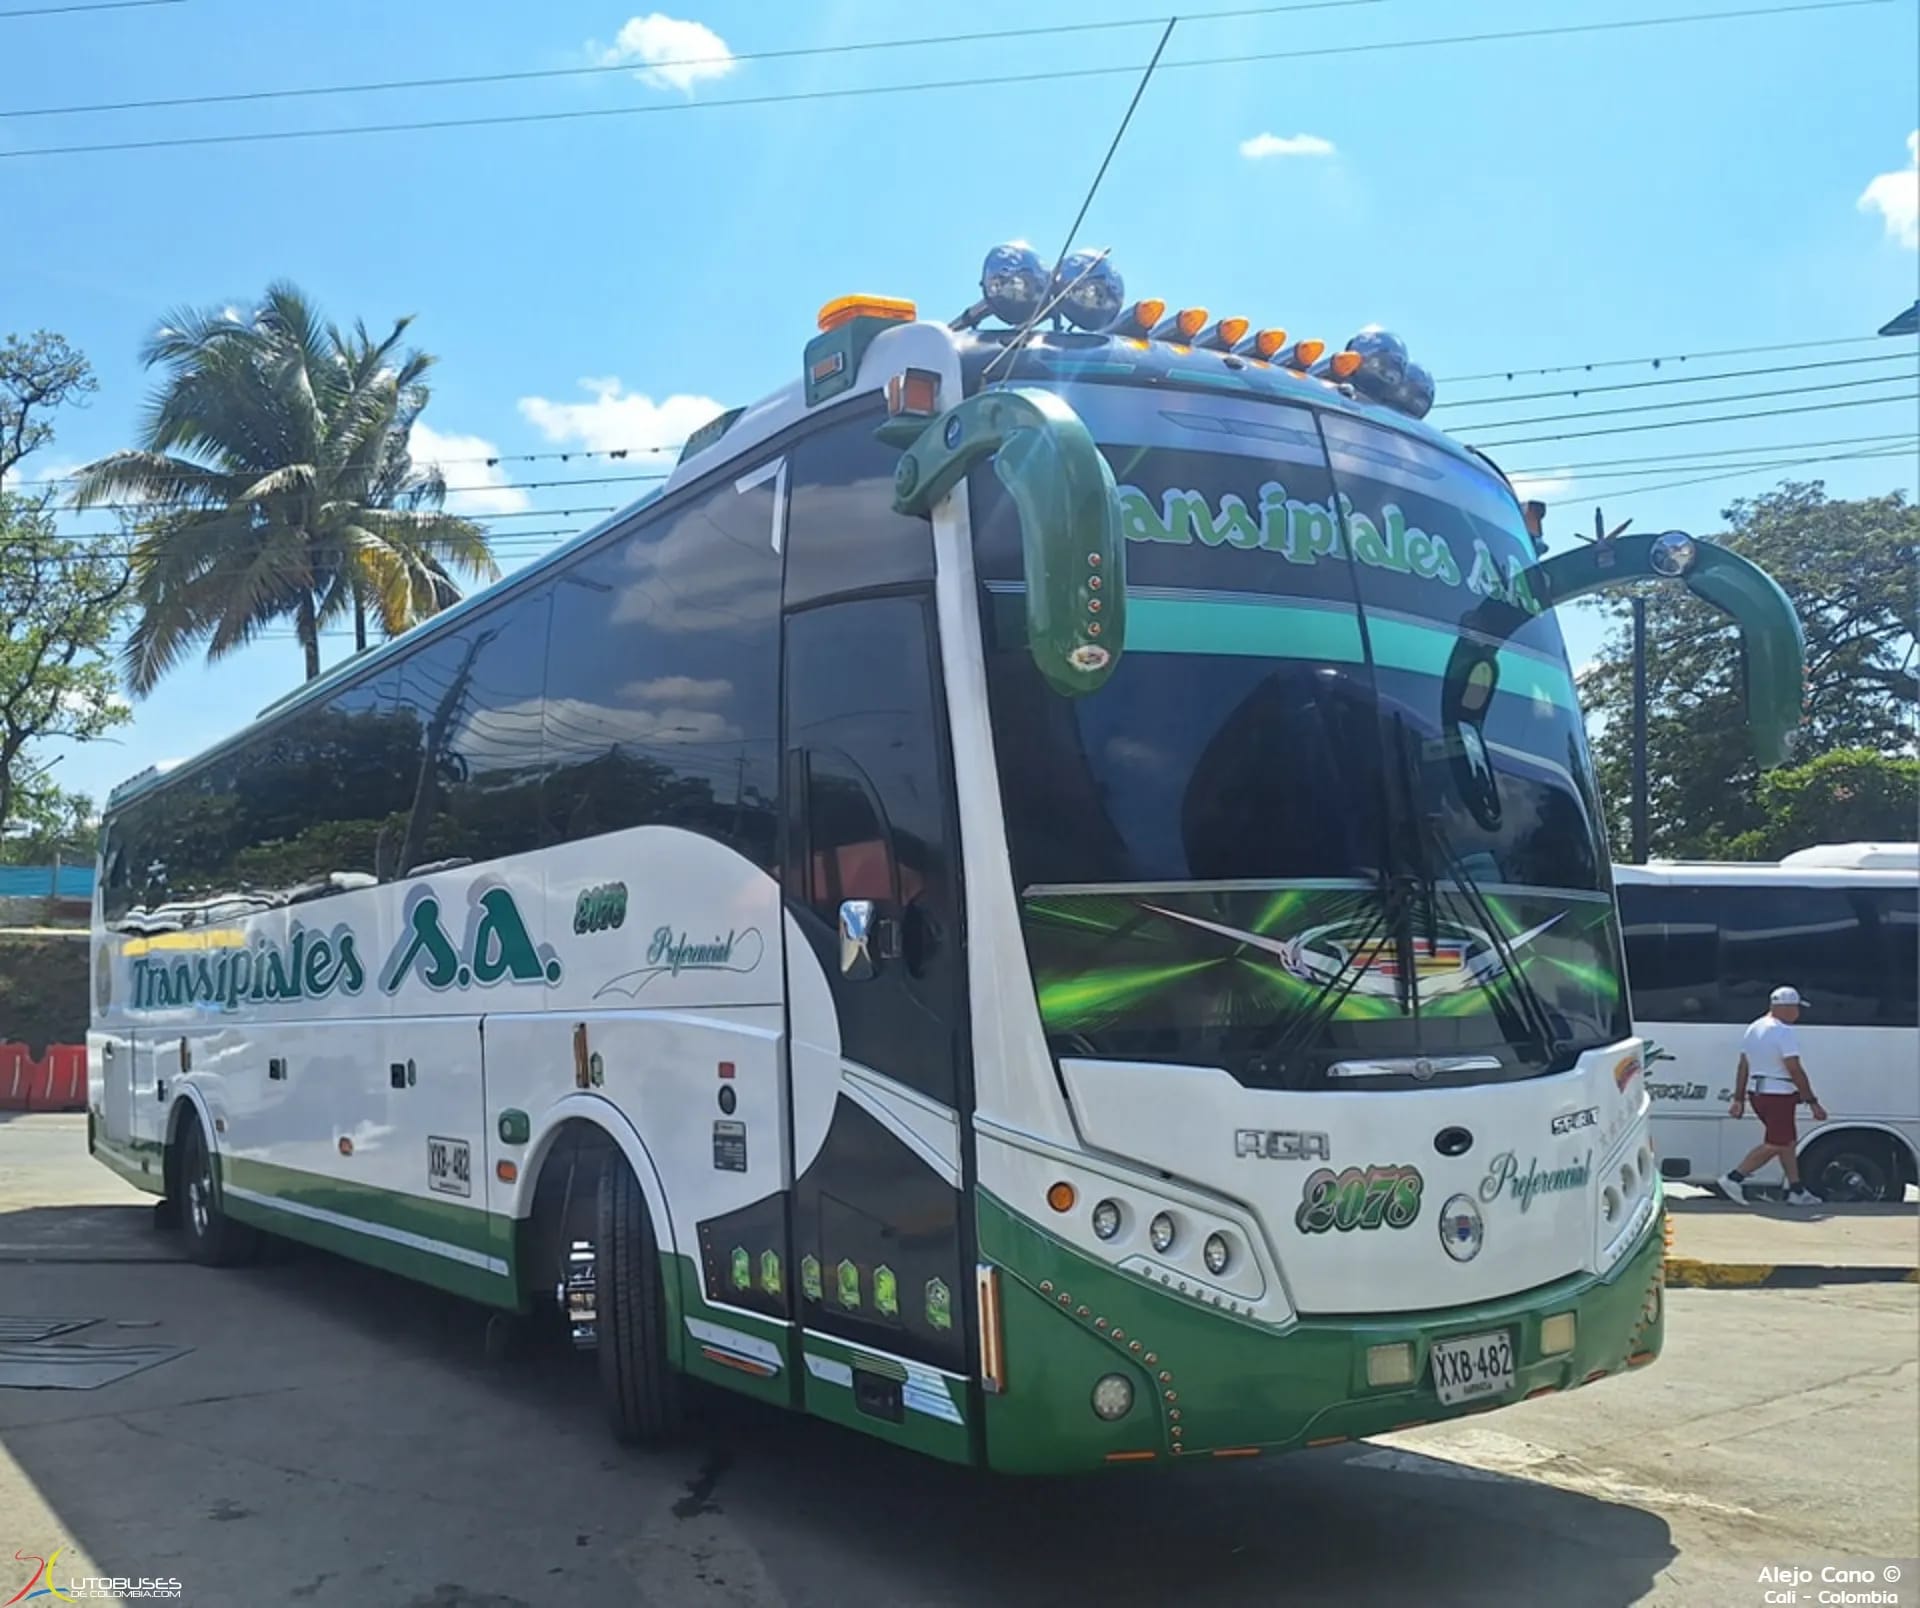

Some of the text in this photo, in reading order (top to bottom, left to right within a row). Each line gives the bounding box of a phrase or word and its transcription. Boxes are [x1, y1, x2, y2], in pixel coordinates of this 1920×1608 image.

[132, 922, 365, 1012] Transipiales
[1234, 1128, 1330, 1161] AGA
[1295, 1164, 1424, 1234] 2078
[1479, 1148, 1593, 1214] Preferencial
